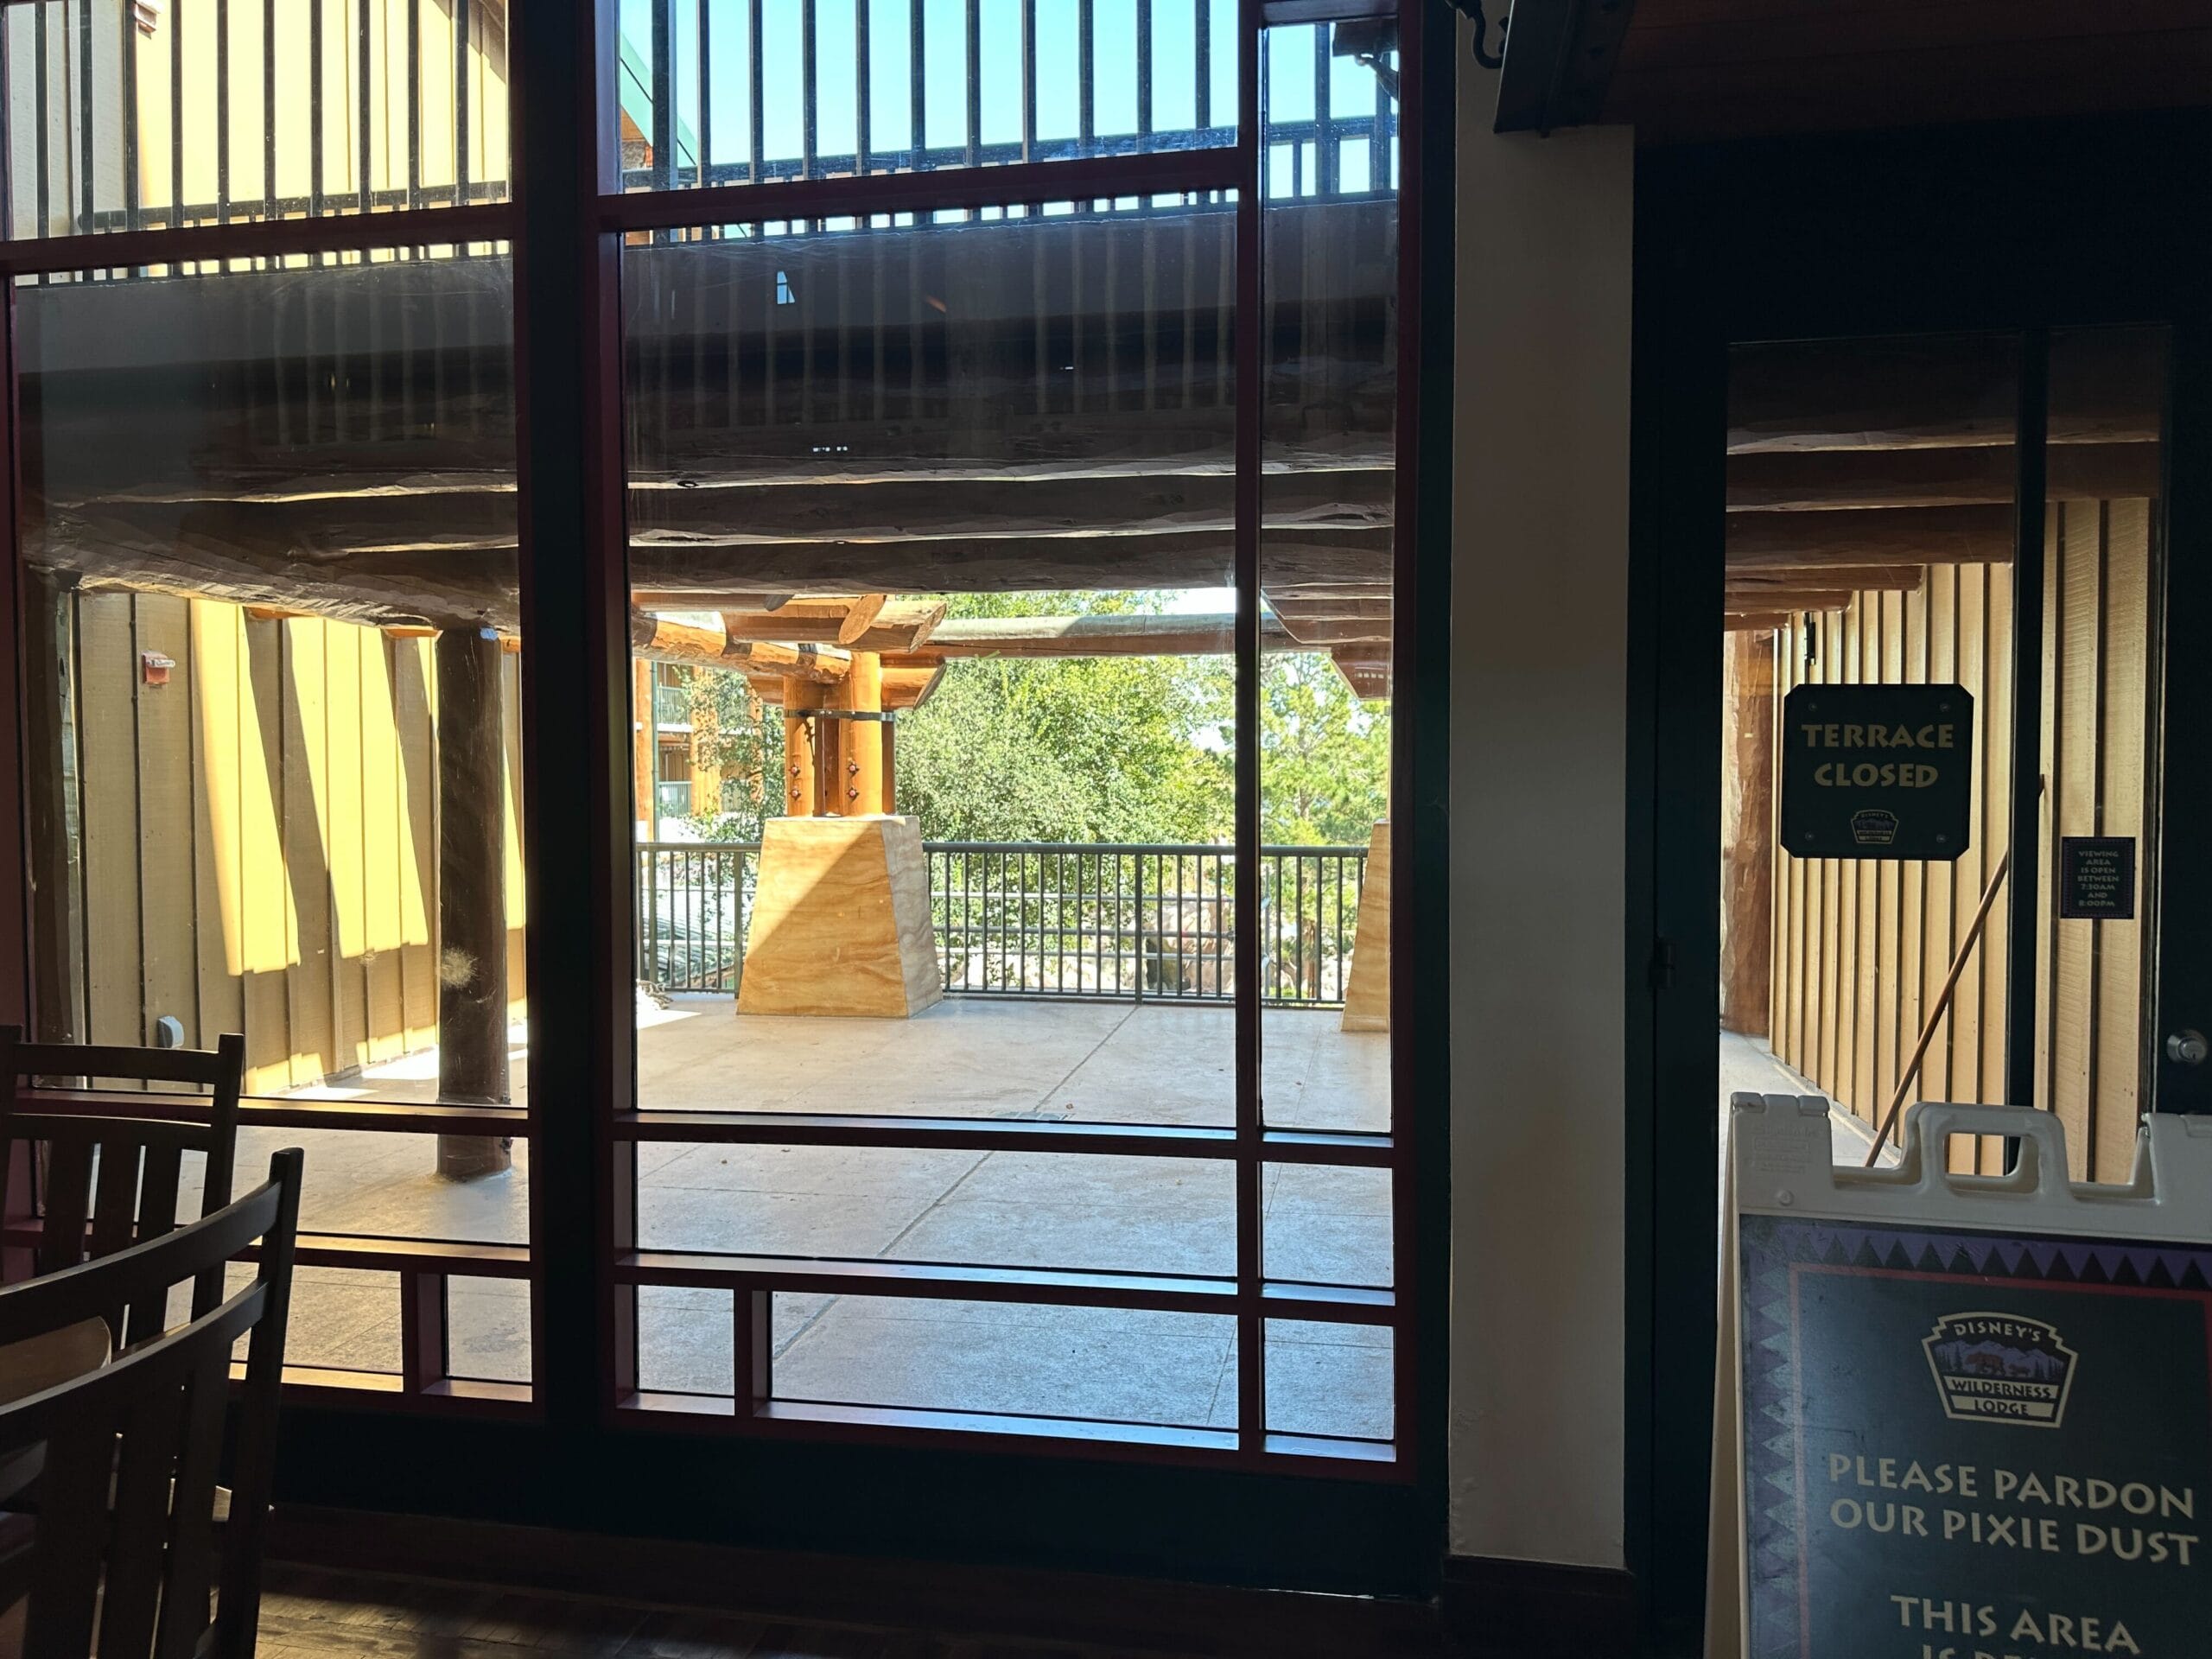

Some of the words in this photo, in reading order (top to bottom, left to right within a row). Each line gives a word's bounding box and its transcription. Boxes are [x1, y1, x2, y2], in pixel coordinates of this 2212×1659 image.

[1801, 723, 1954, 748] TERRACE
[1815, 762, 1938, 788] CLOSED
[1954, 1321, 2041, 1342] DISNEY'S
[1952, 1379, 2051, 1399] WILDERNESS
[1974, 1399, 2029, 1415] LODGE
[1828, 1453, 1978, 1497] PLEASE
[1993, 1469, 2194, 1519] PARDON
[1829, 1498, 1929, 1537] OUR
[1942, 1510, 2060, 1552] PIXIE
[2076, 1523, 2199, 1566] DUST
[1891, 1595, 1997, 1637] THIS
[2009, 1608, 2141, 1656] AREA
